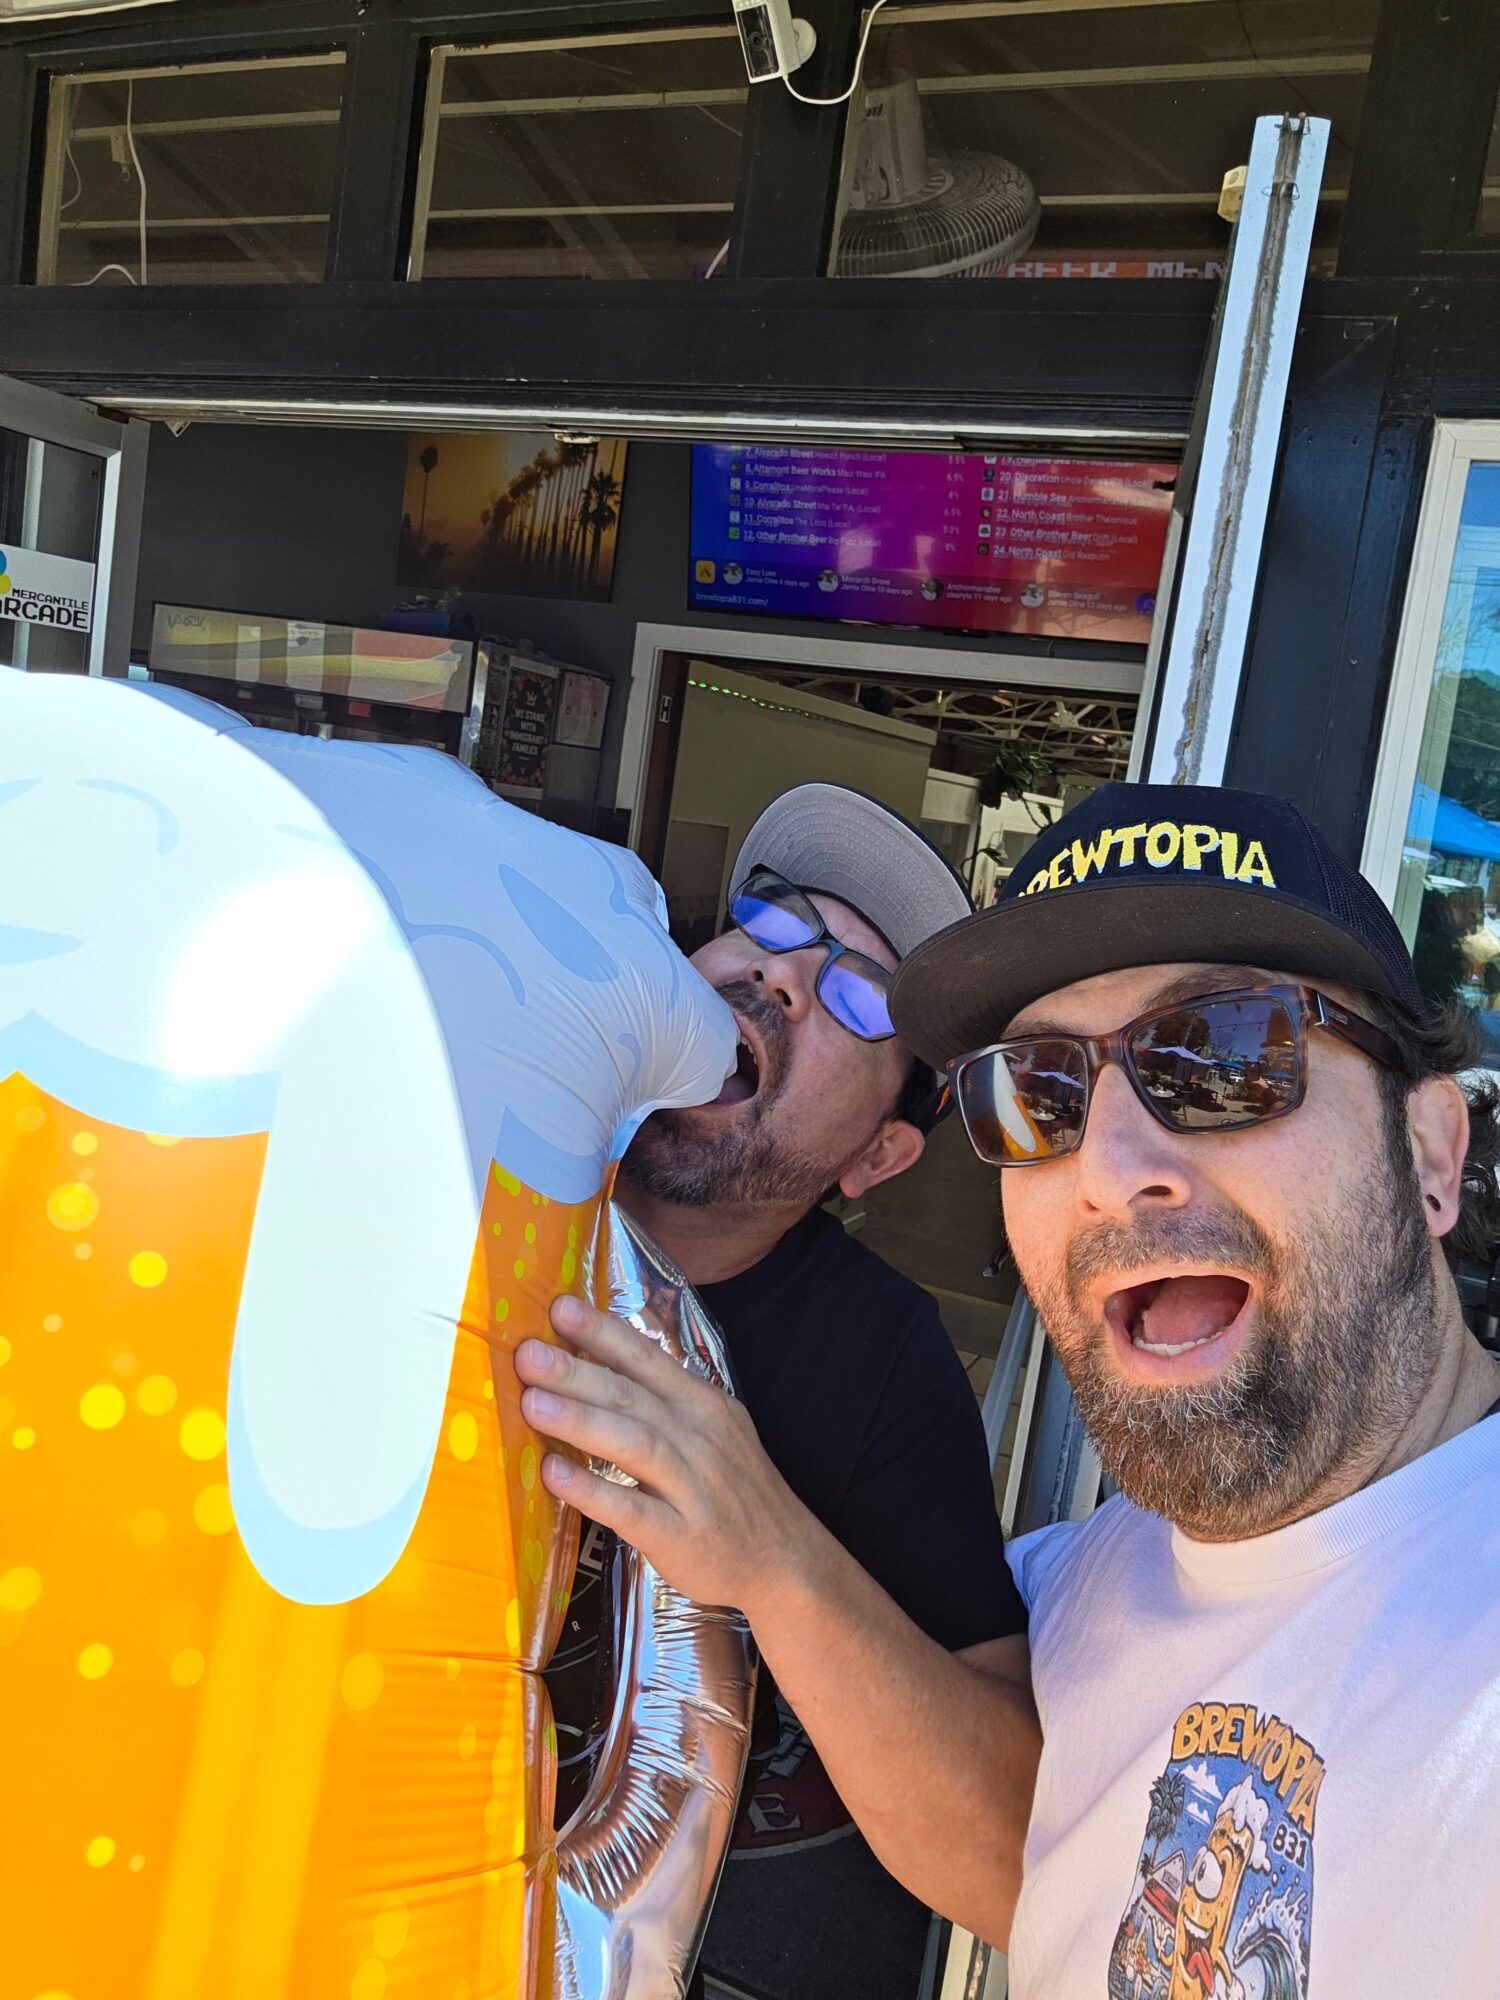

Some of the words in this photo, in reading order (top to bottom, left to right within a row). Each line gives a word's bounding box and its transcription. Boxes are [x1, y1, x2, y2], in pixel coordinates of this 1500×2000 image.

[791, 466, 810, 475] Beer
[1012, 509, 1037, 520] North
[1039, 511, 1066, 522] Coast
[1008, 546, 1033, 557] North
[1035, 547, 1061, 558] Coast
[12, 588, 89, 610] MERCANTILE
[0, 597, 88, 629] RCADE
[1018, 821, 1276, 898] REWTOPIA
[1170, 1701, 1327, 1840] BREWTOPIA
[1271, 1823, 1308, 1869] 831
